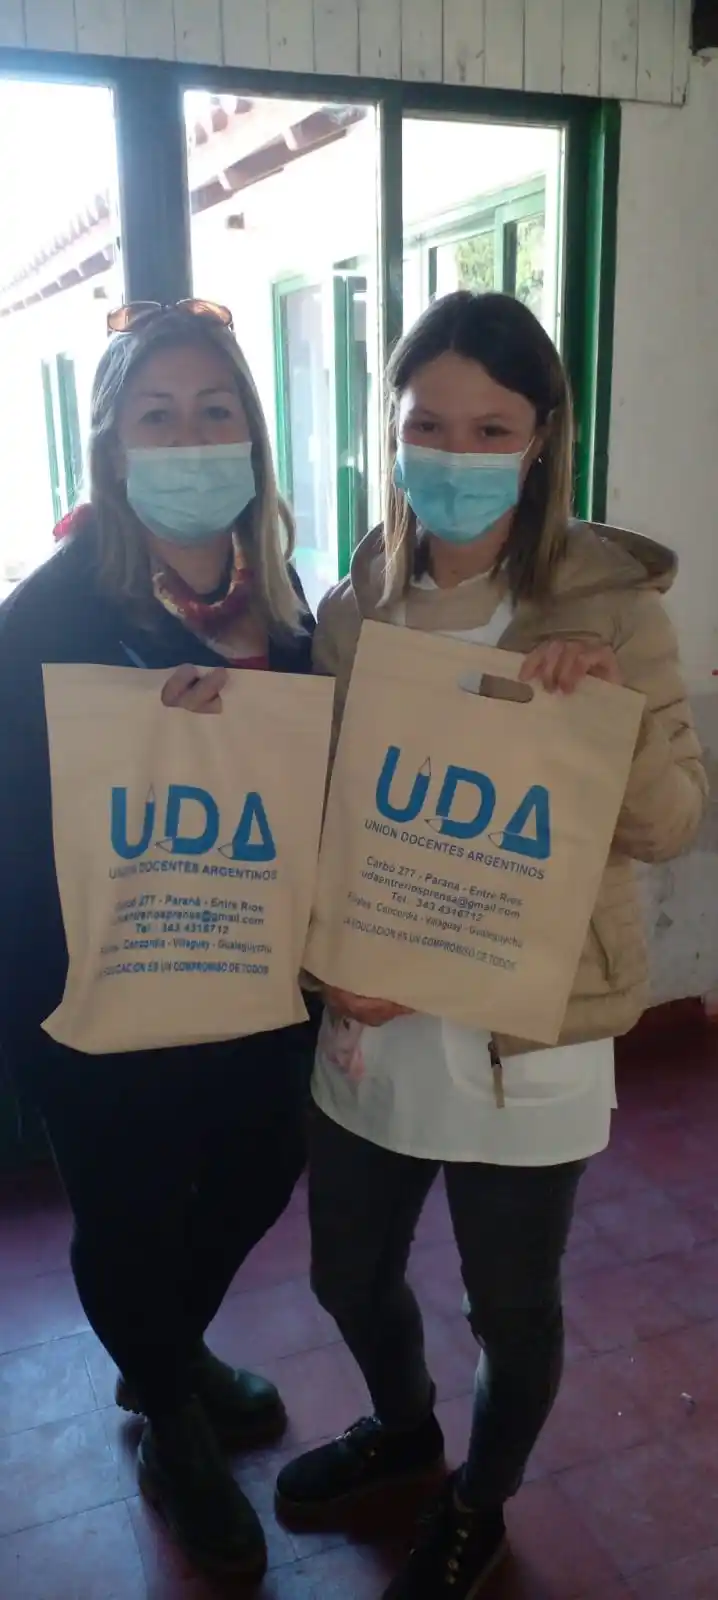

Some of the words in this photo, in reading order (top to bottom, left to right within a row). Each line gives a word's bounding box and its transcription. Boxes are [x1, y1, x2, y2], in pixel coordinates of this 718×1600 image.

[110, 784, 277, 862] UDA
[376, 745, 550, 860] UDA
[202, 864, 278, 881] ARGENTINOS
[364, 818, 398, 839] UNION
[400, 831, 465, 858] DOCENTES
[467, 850, 545, 880] ARGENTINOS
[397, 865, 416, 878] 277
[469, 885, 497, 900] Entre
[416, 898, 435, 911] 343
